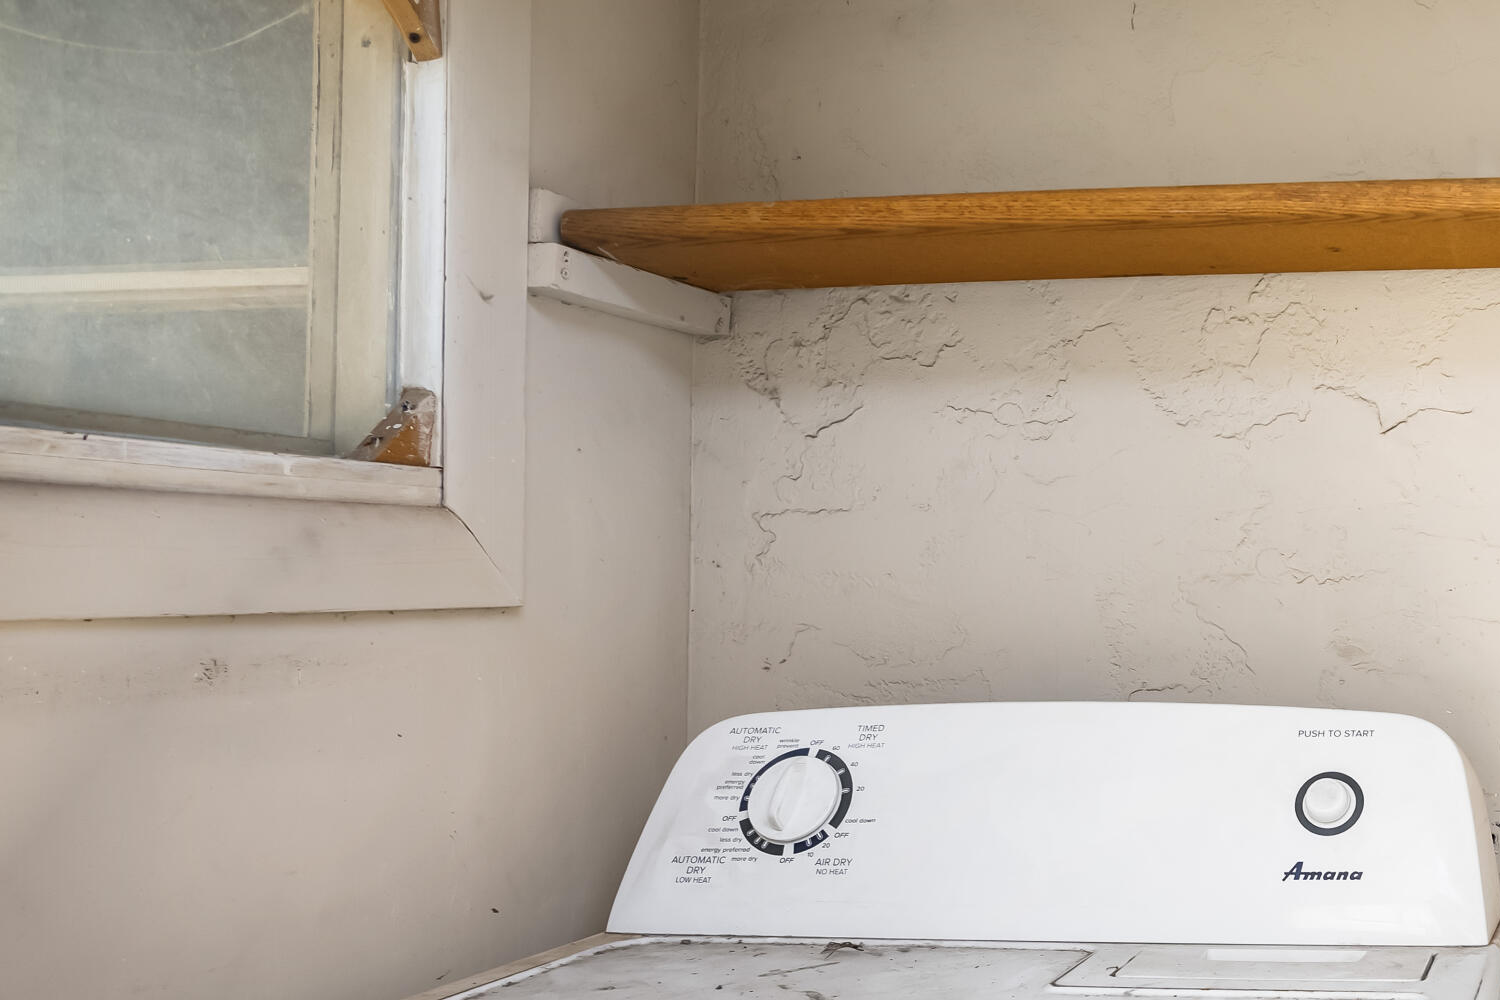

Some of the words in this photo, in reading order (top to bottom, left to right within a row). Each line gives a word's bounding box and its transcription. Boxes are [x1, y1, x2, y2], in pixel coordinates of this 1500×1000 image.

[730, 726, 782, 734] AUTOMATIC
[1298, 730, 1325, 738] PUSH
[671, 856, 726, 864] AUTOMATIC
[832, 858, 853, 866] DRY
[686, 866, 706, 874] DRY
[1282, 861, 1364, 882] Amana
